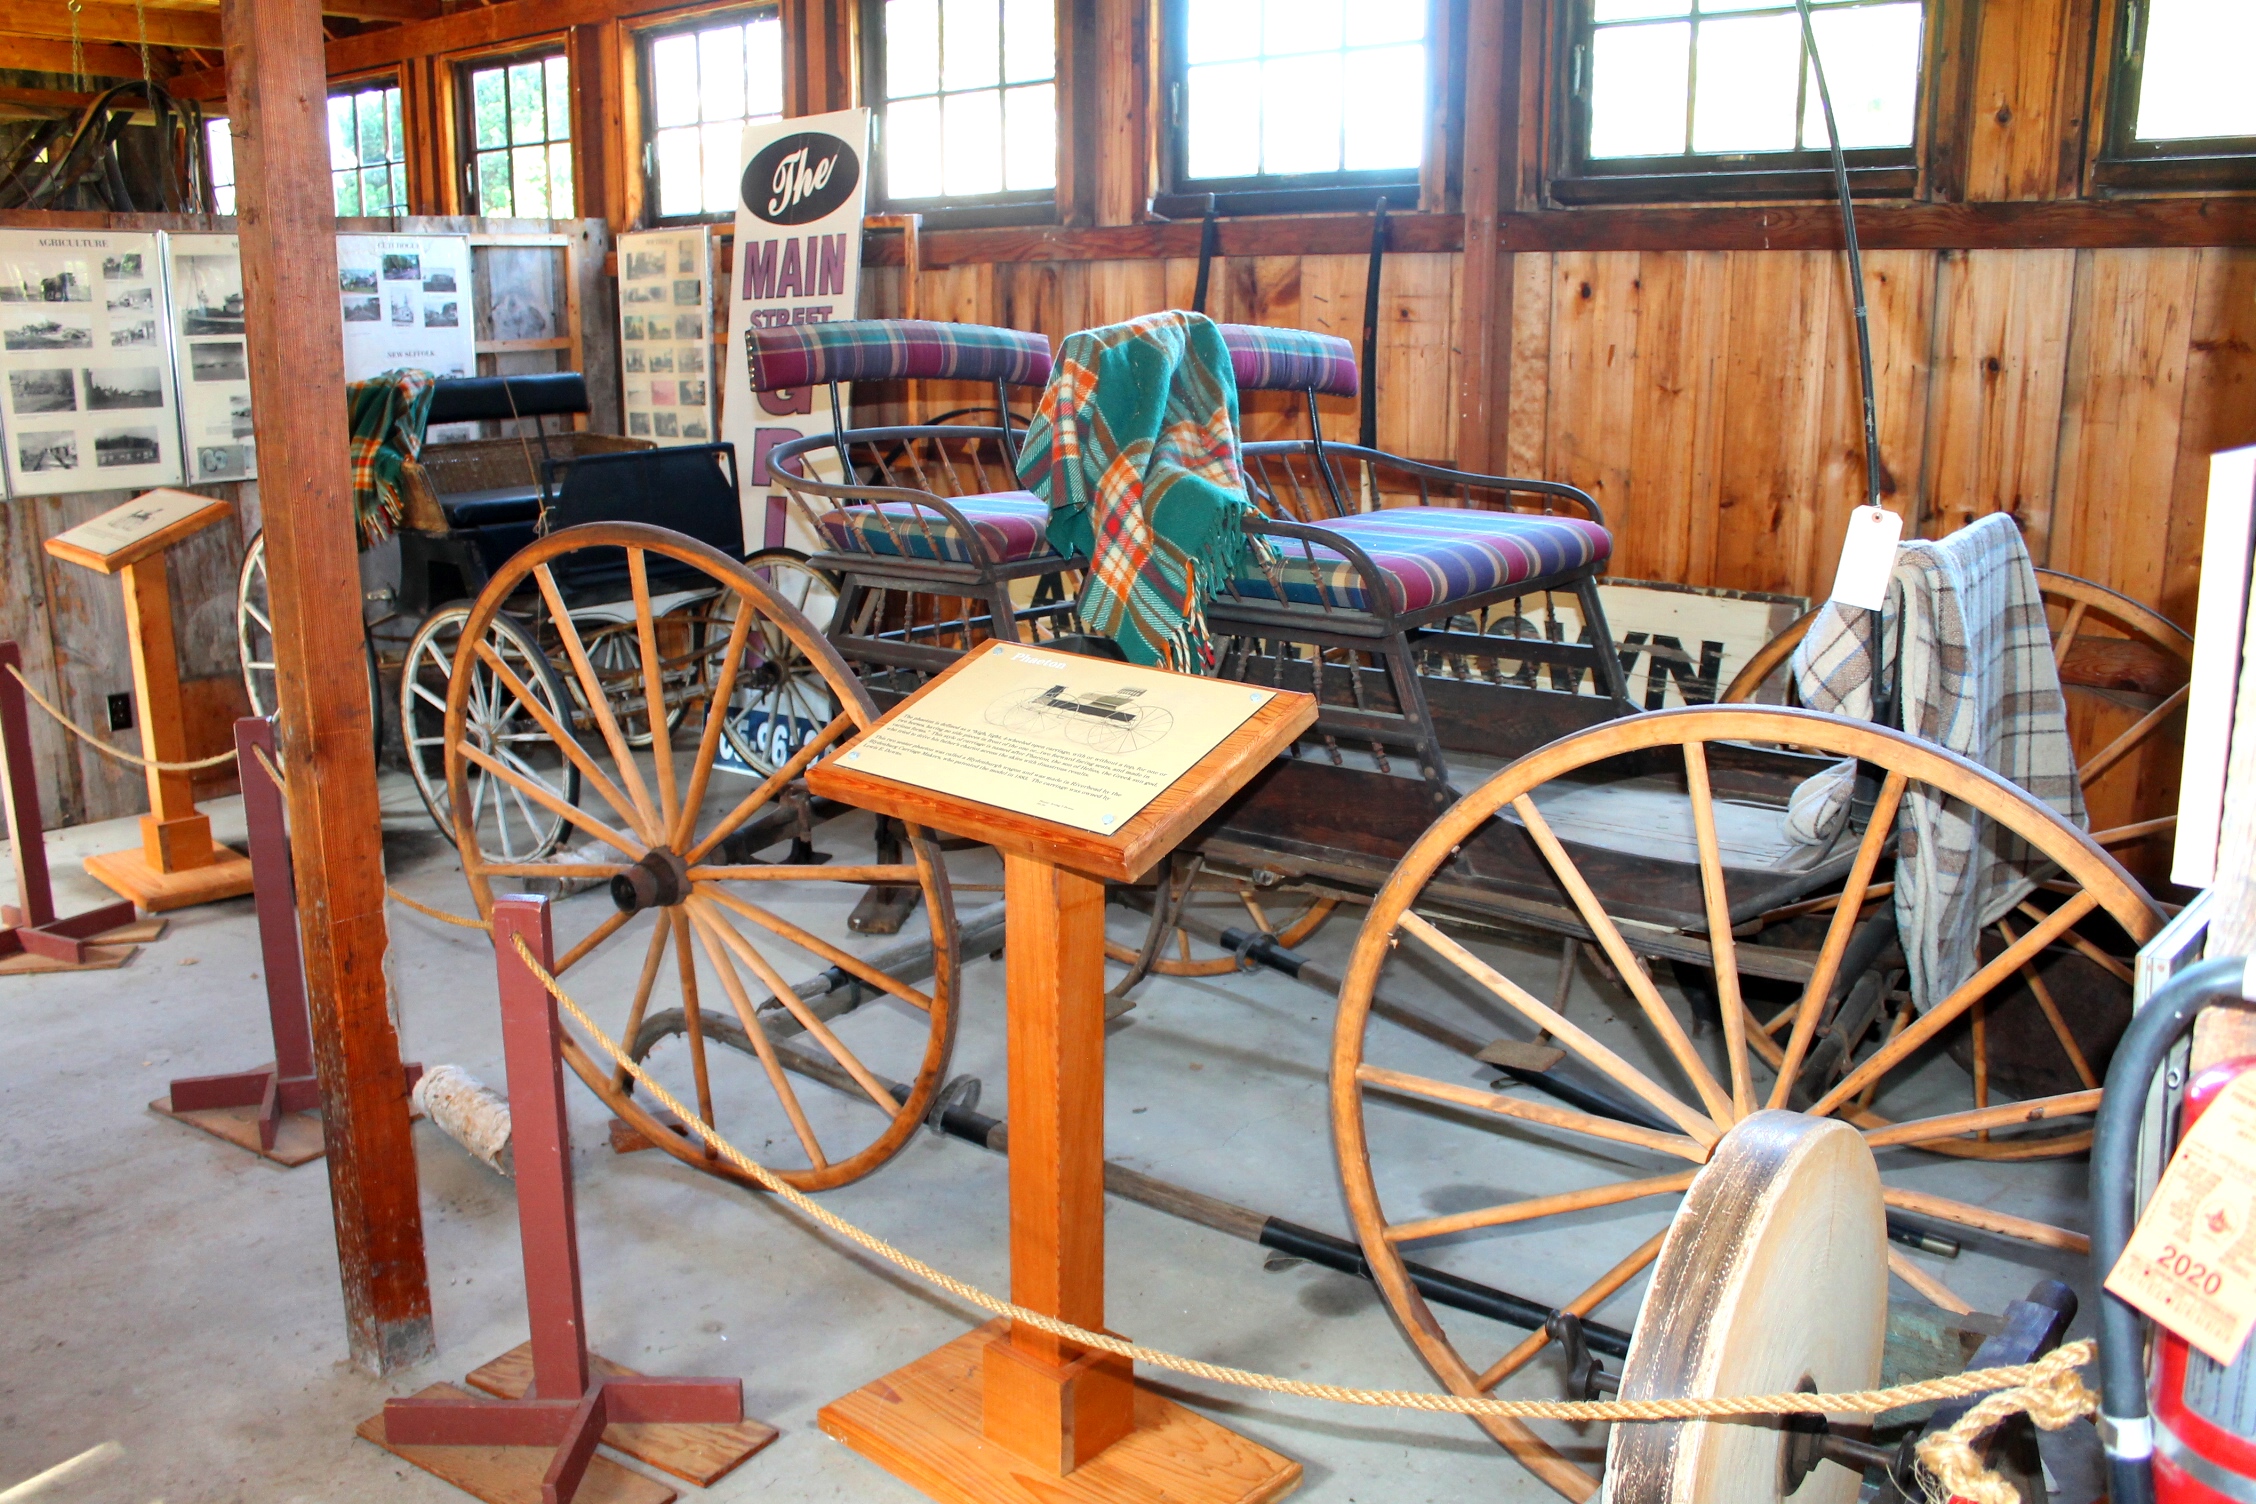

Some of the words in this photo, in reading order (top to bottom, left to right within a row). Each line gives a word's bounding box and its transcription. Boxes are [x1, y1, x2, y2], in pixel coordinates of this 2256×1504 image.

[767, 147, 838, 217] The
[38, 238, 108, 248] AGRICULTURE
[742, 233, 847, 300] MAIN
[1010, 652, 1067, 670] Phaeton
[2157, 1245, 2222, 1295] 2020
